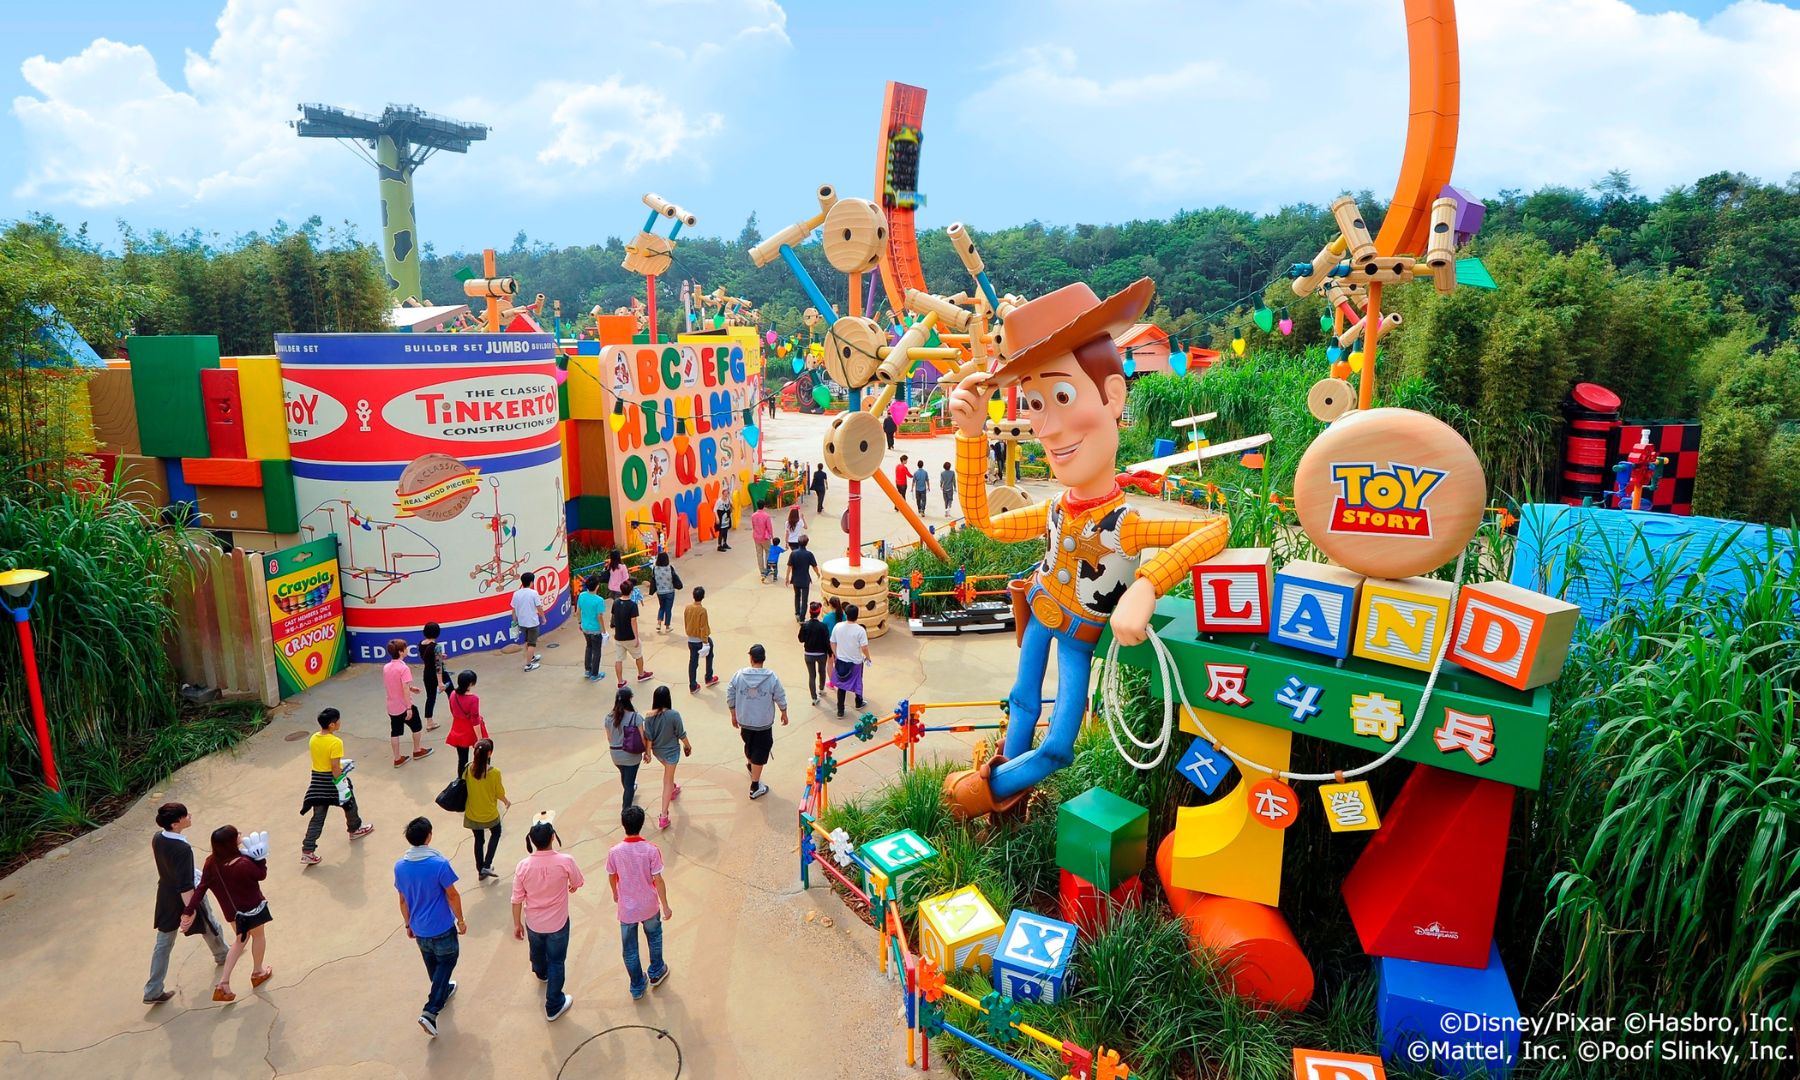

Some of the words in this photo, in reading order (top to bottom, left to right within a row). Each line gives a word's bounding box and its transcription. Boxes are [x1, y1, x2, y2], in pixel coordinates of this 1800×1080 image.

[303, 344, 319, 353] SET
[405, 344, 458, 353] BUILDER
[463, 343, 484, 352] SET
[485, 341, 530, 354] JUMBO
[465, 390, 495, 398] THE
[500, 385, 546, 396] CLASSIC
[293, 428, 308, 437] SET
[443, 420, 544, 436] CONSTRUCTION
[546, 416, 556, 425] SET
[422, 463, 460, 478] CLASSIC
[404, 497, 423, 506] REAL
[423, 487, 446, 501] WOOD
[425, 508, 453, 518] SINCE
[1342, 509, 1422, 531] STORY
[269, 560, 279, 574] 8
[277, 570, 330, 598] Crayola
[532, 571, 556, 595] 02
[284, 623, 336, 657] CRAYONS
[361, 627, 516, 659] EDCTIONAL
[310, 657, 318, 669] 8
[1205, 663, 1497, 764] 反斗奇兵
[1185, 751, 1367, 825] 大本營
[1011, 922, 1064, 963] X
